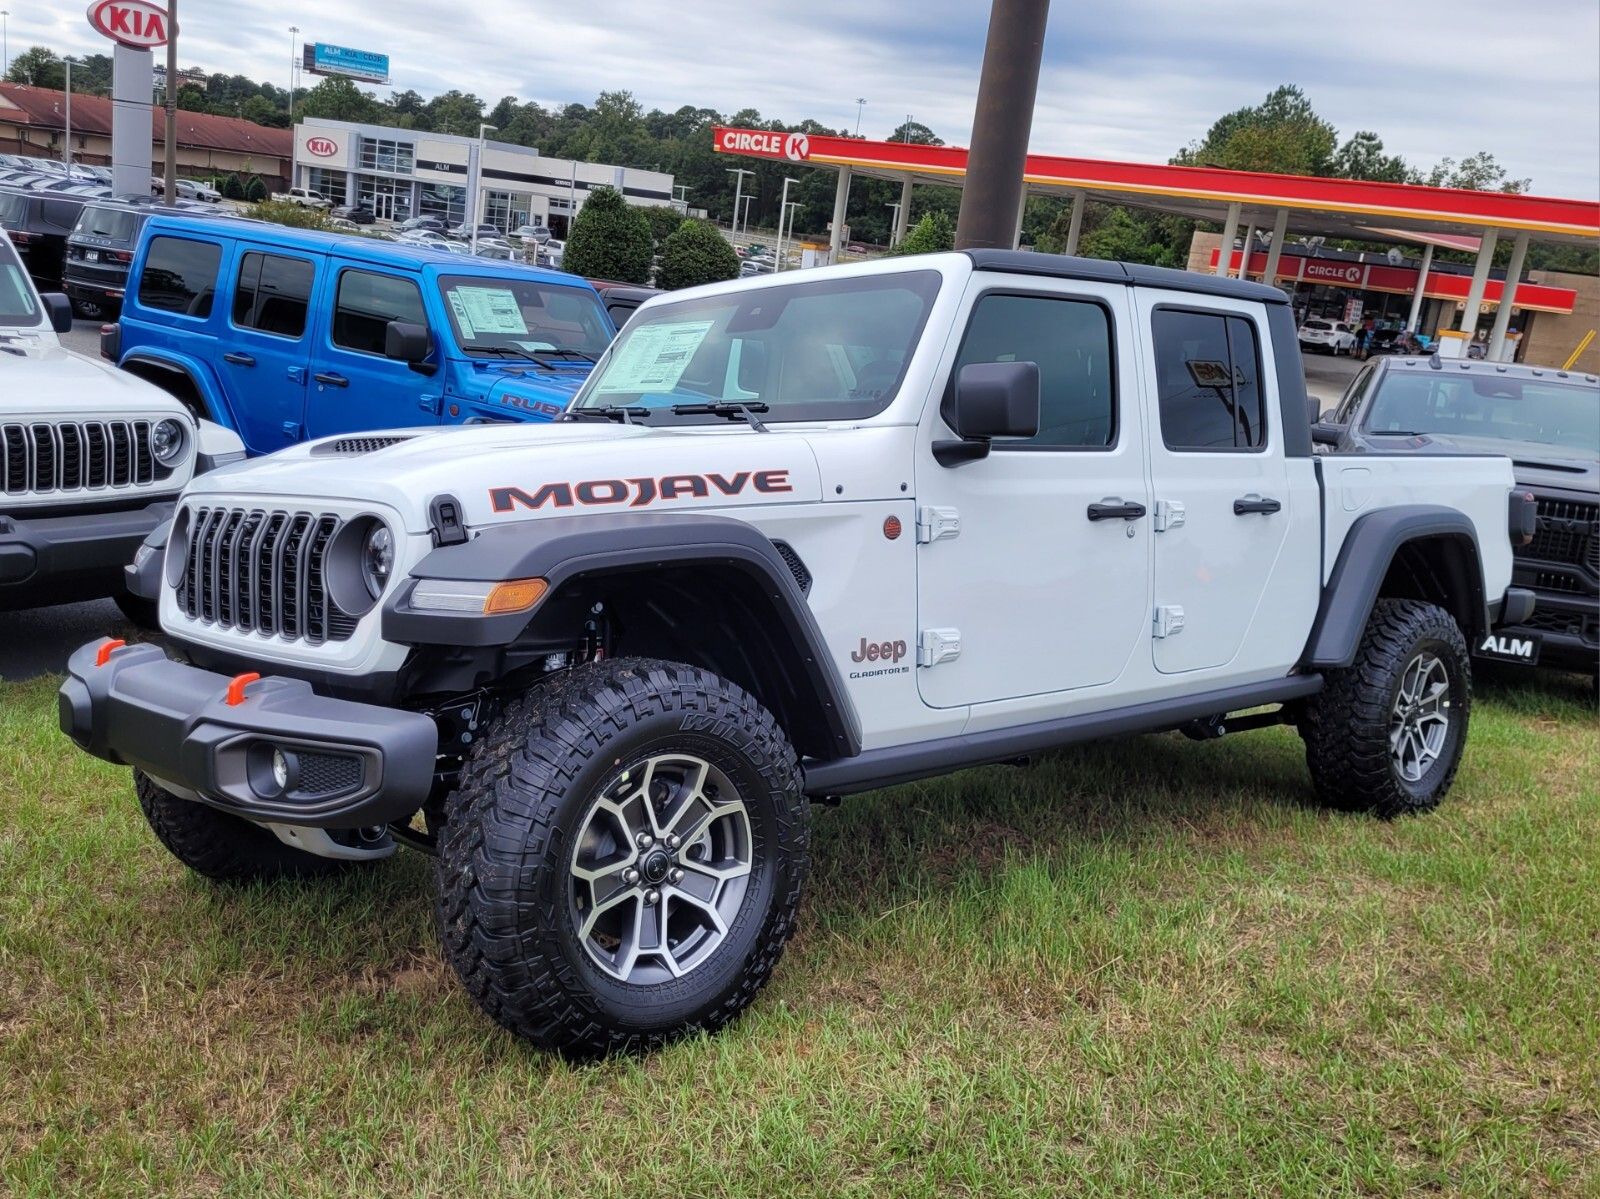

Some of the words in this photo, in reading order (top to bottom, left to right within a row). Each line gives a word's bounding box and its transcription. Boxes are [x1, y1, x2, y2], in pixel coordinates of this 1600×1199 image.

[109, 5, 167, 41] KIA
[311, 140, 333, 154] KIA
[723, 132, 782, 153] CIRCLE
[790, 136, 808, 160] K
[435, 162, 450, 171] ALM
[86, 252, 98, 260] ALM
[1307, 265, 1344, 278] CIRCLE
[1347, 268, 1359, 281] K
[488, 469, 793, 513] MOJAVE
[851, 637, 907, 663] Jeep
[1480, 635, 1534, 658] ALM
[849, 667, 901, 679] GLADIATOR
